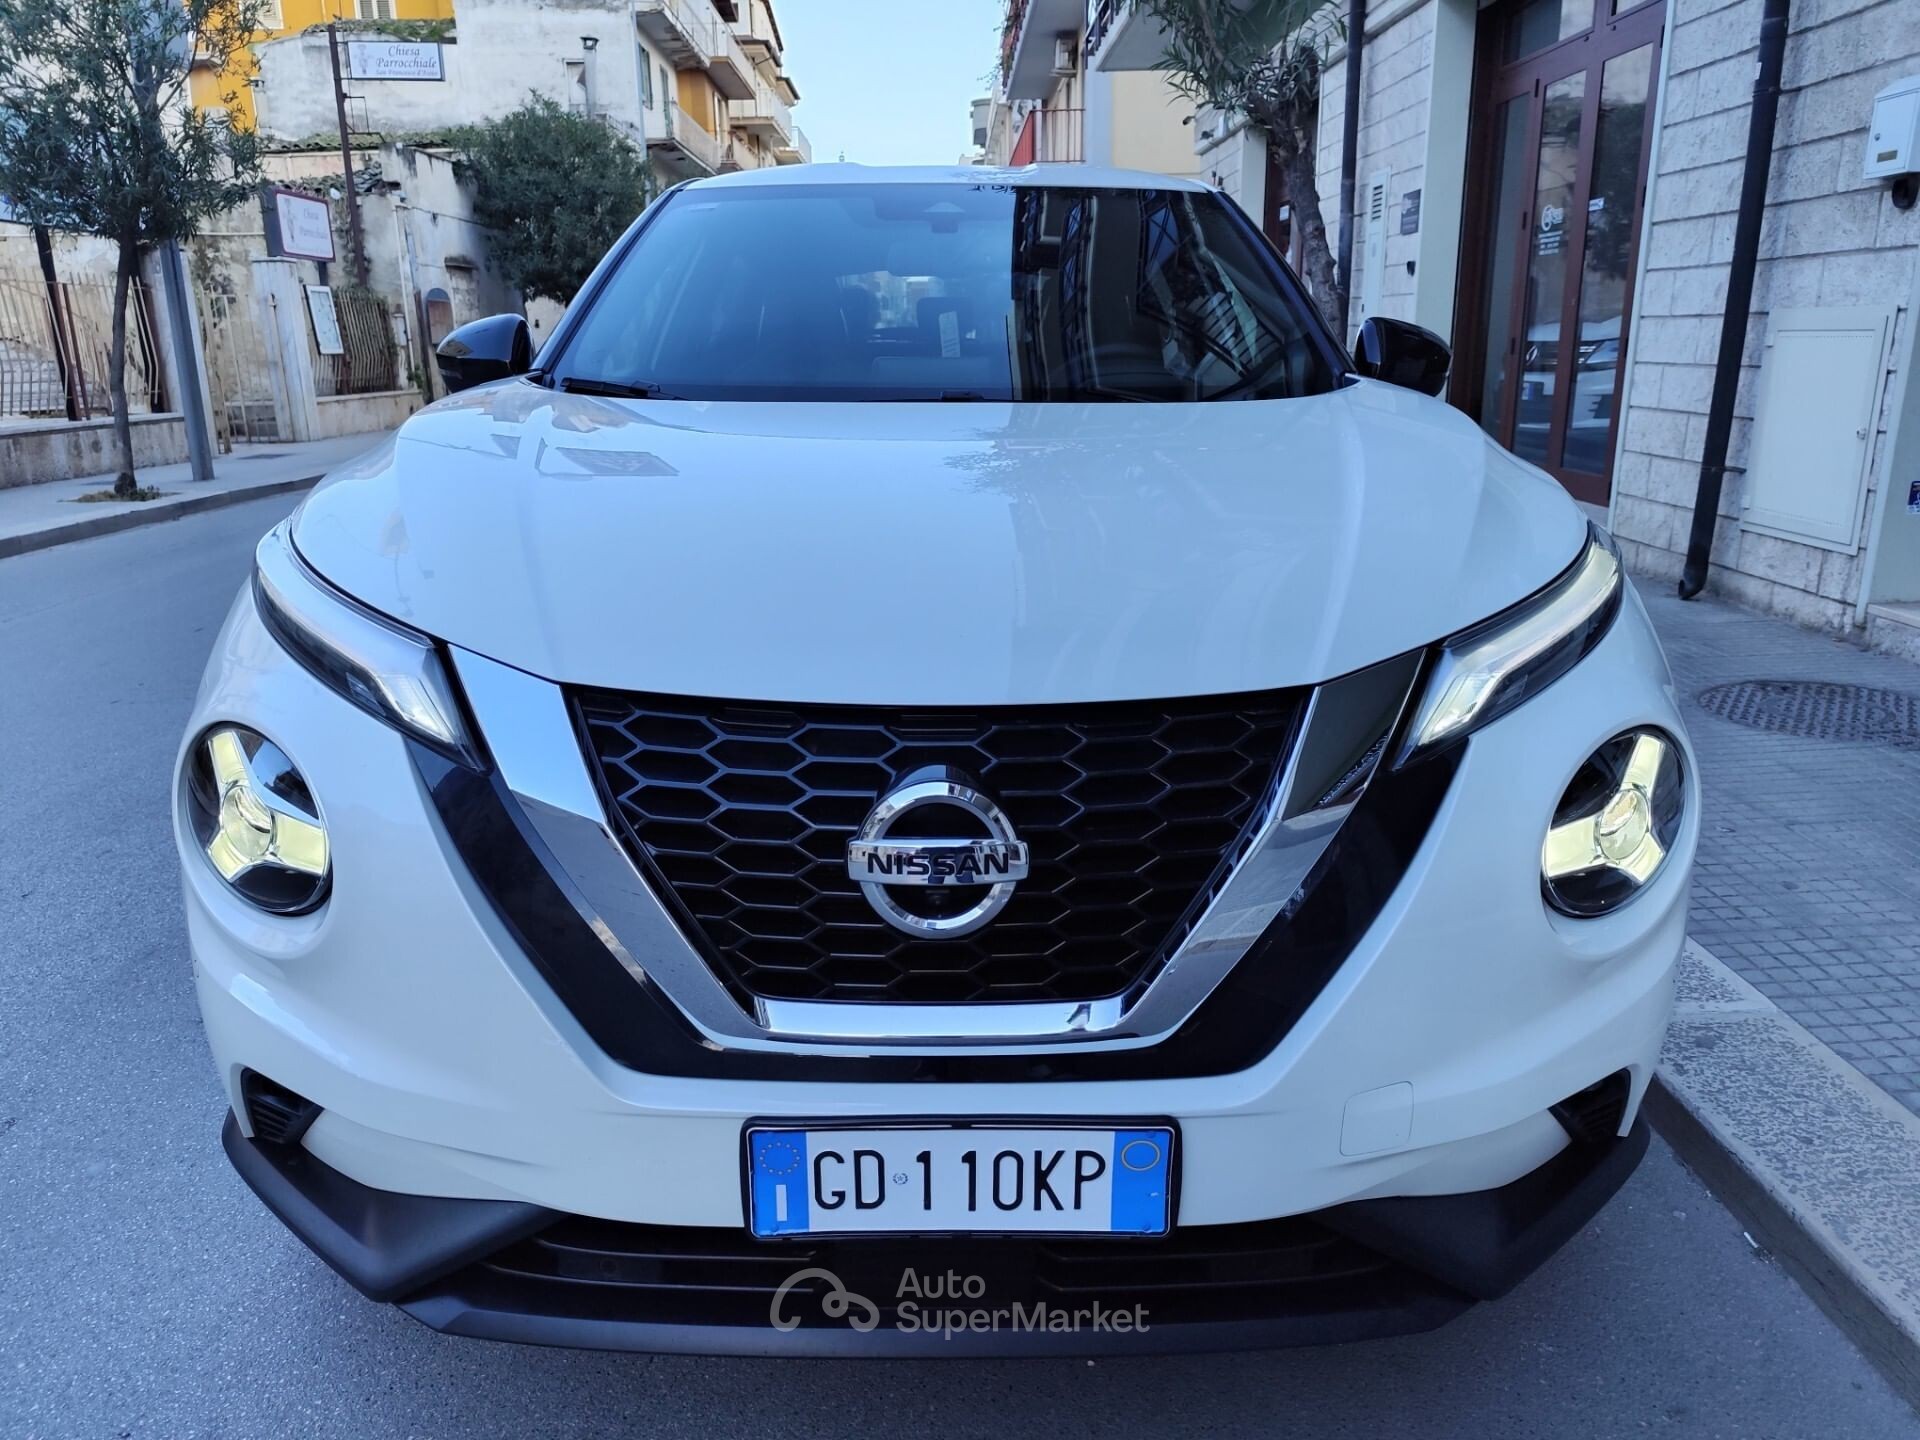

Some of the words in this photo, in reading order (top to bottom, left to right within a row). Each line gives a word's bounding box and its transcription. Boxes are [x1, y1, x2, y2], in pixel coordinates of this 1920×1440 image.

[388, 44, 420, 57] Chiesa
[376, 56, 437, 69] Parrocchiale
[867, 853, 1009, 876] NISSAN
